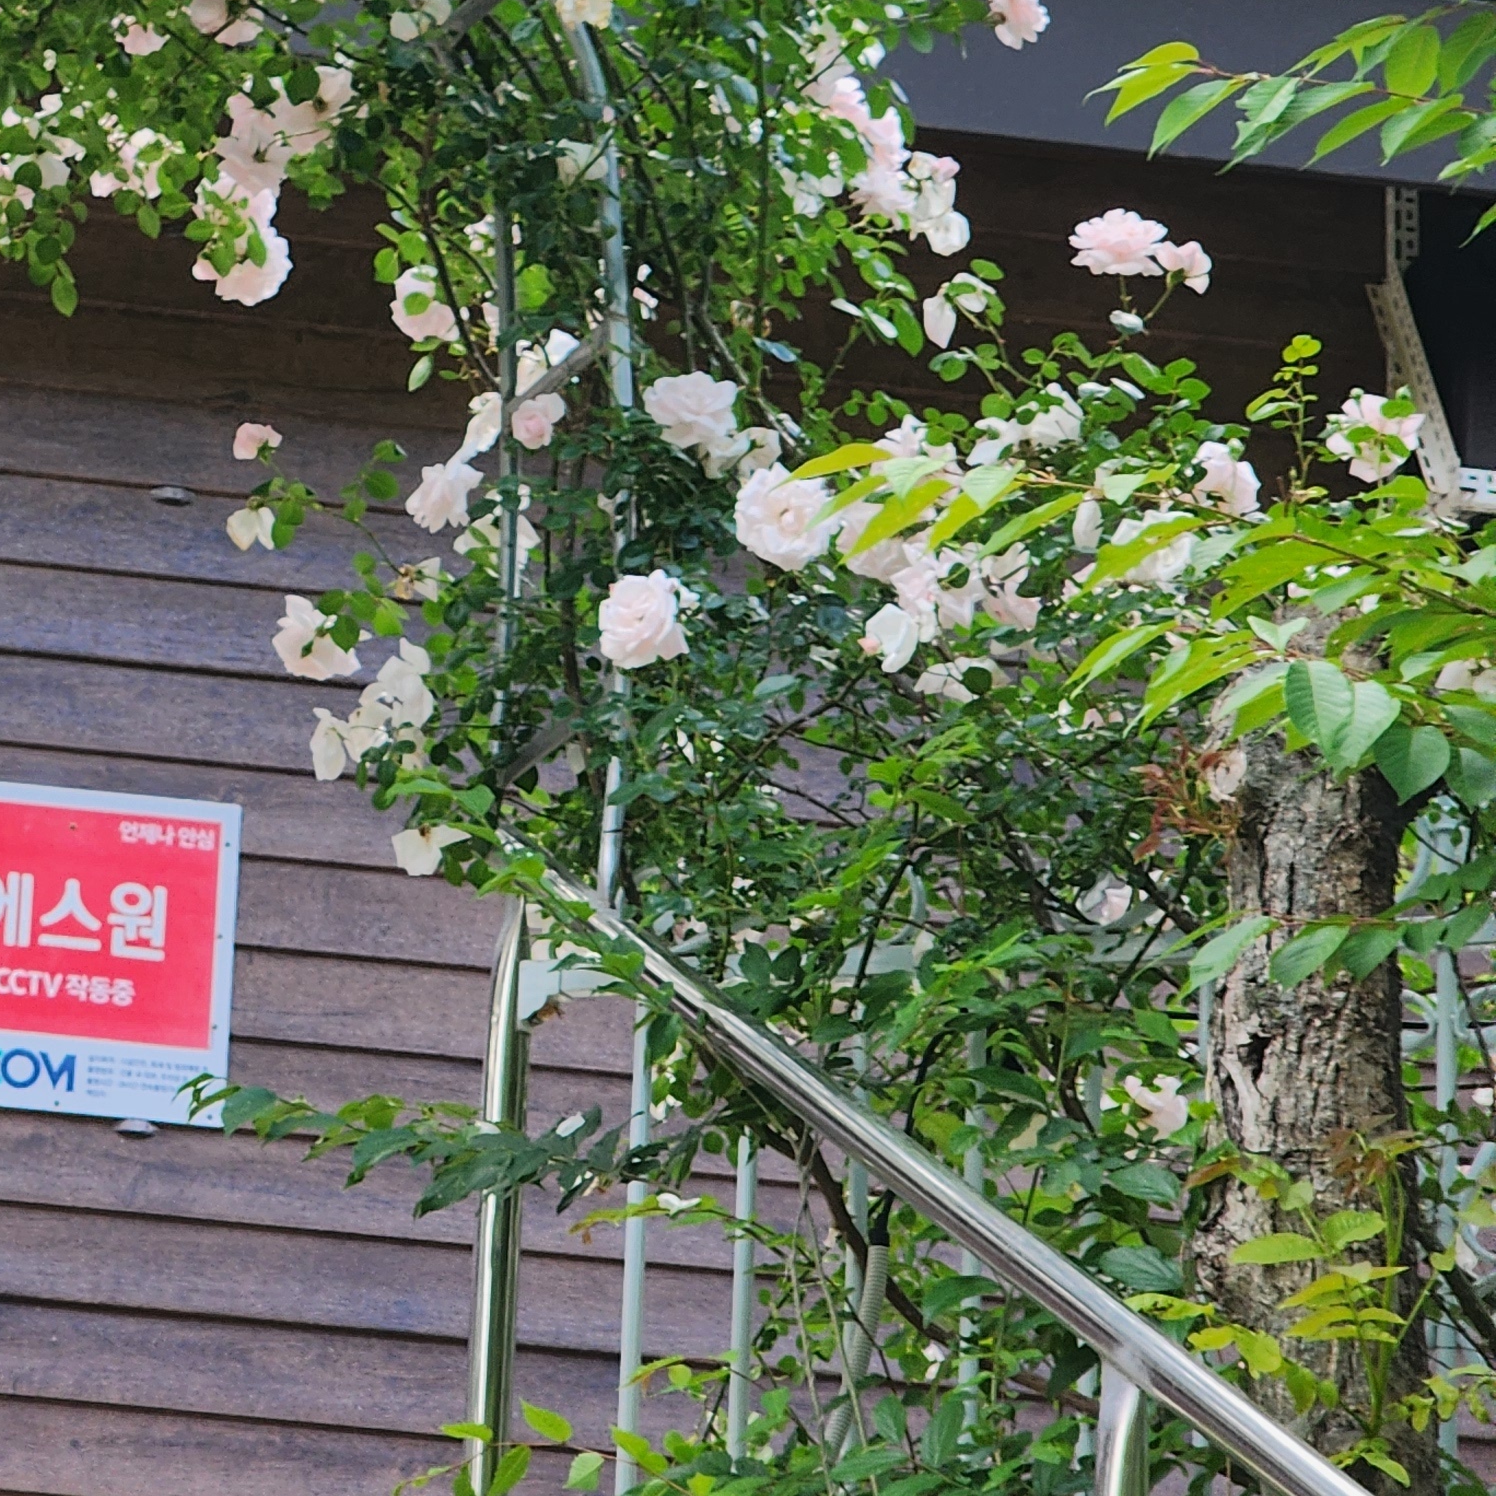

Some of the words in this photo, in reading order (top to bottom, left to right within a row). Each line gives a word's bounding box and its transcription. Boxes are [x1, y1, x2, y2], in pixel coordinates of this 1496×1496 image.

[119, 820, 175, 846] 언제나
[177, 826, 215, 851] 안심
[65, 973, 136, 1006] 작동중
